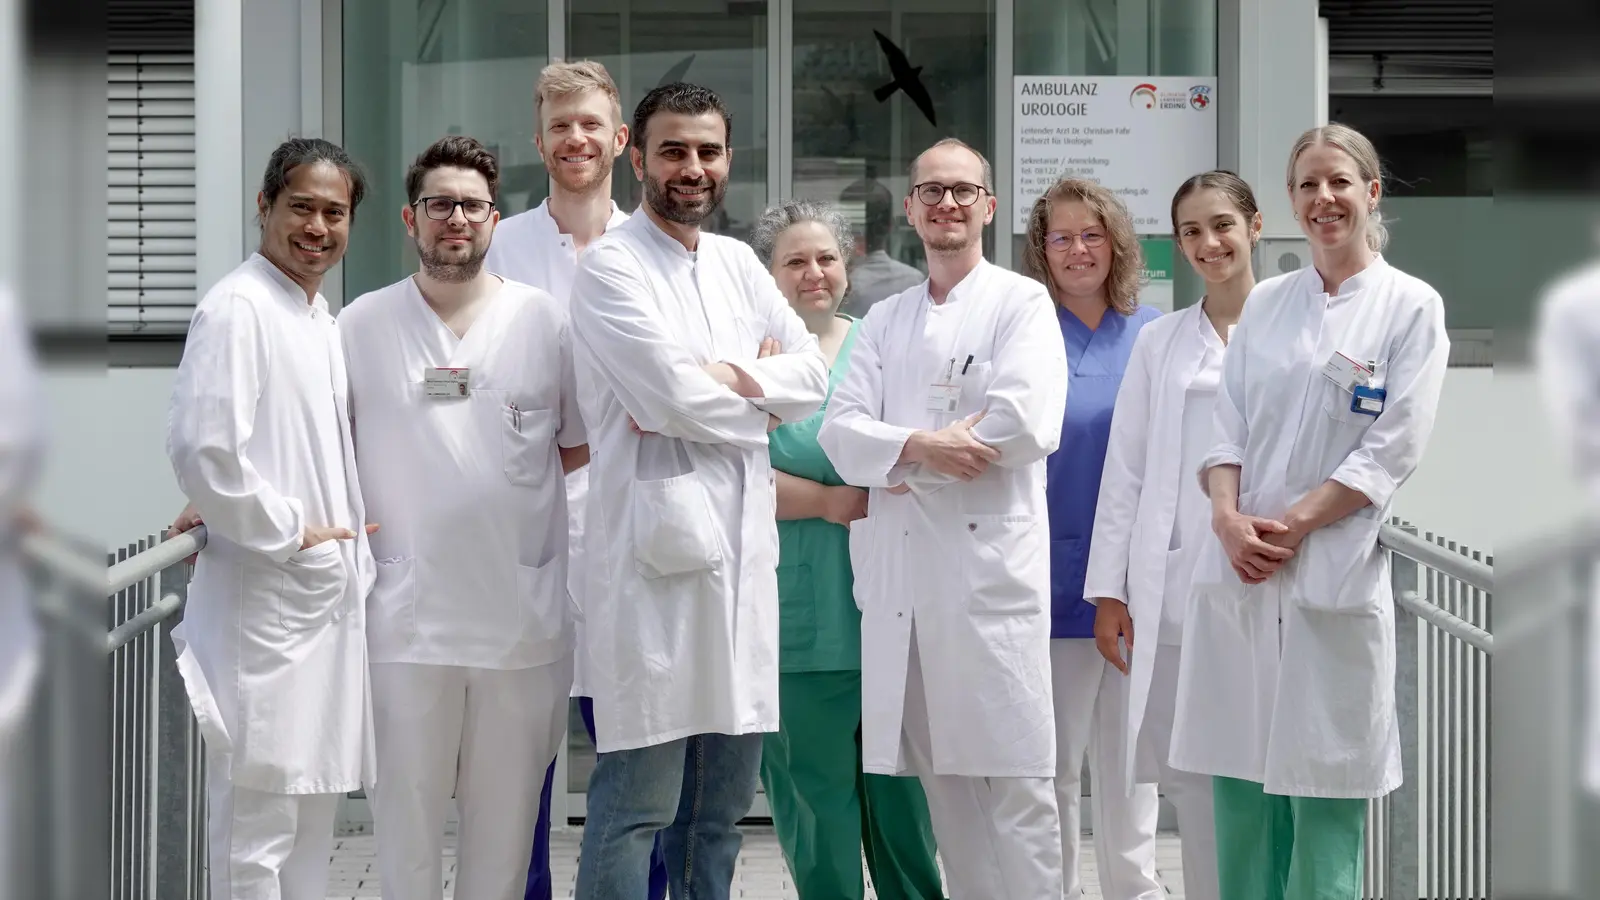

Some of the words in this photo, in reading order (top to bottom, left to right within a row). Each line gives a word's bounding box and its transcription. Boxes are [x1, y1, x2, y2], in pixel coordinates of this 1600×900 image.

[1021, 83, 1098, 96] AMBULANZ
[1021, 103, 1088, 116] UROLOGIE
[1021, 126, 1053, 135] Leitender
[1056, 127, 1070, 135] Arzt
[1083, 126, 1114, 135] Christian
[1020, 137, 1050, 145] Facharzt
[1052, 136, 1061, 145] für
[1063, 137, 1093, 147] Urologie
[1020, 156, 1059, 165] Sekretariat
[1067, 156, 1110, 166] Anmeldung
[1034, 167, 1057, 175] 08122
[1141, 269, 1167, 278] trum
